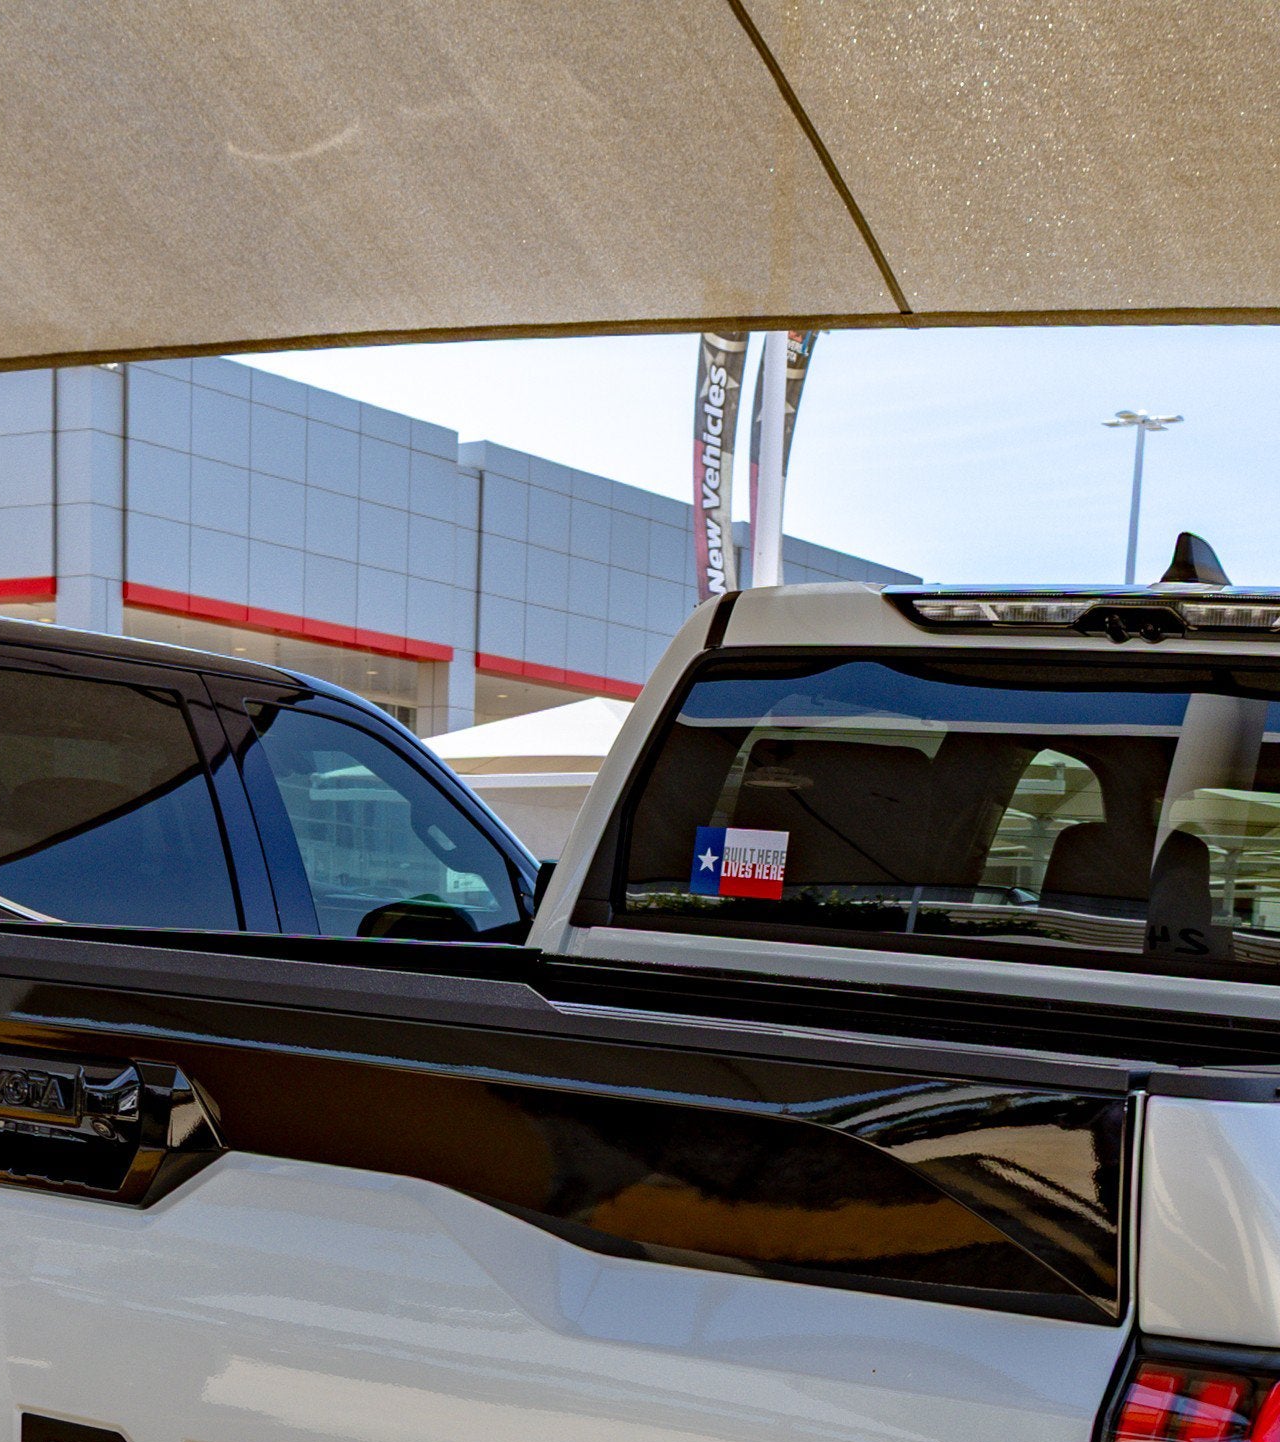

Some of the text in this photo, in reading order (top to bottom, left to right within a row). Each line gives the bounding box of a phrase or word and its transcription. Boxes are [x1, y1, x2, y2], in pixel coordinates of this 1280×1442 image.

[703, 365, 728, 596] New Vehicles
[723, 846, 786, 866] BUILT HERE
[721, 861, 785, 881] LIVES HERE
